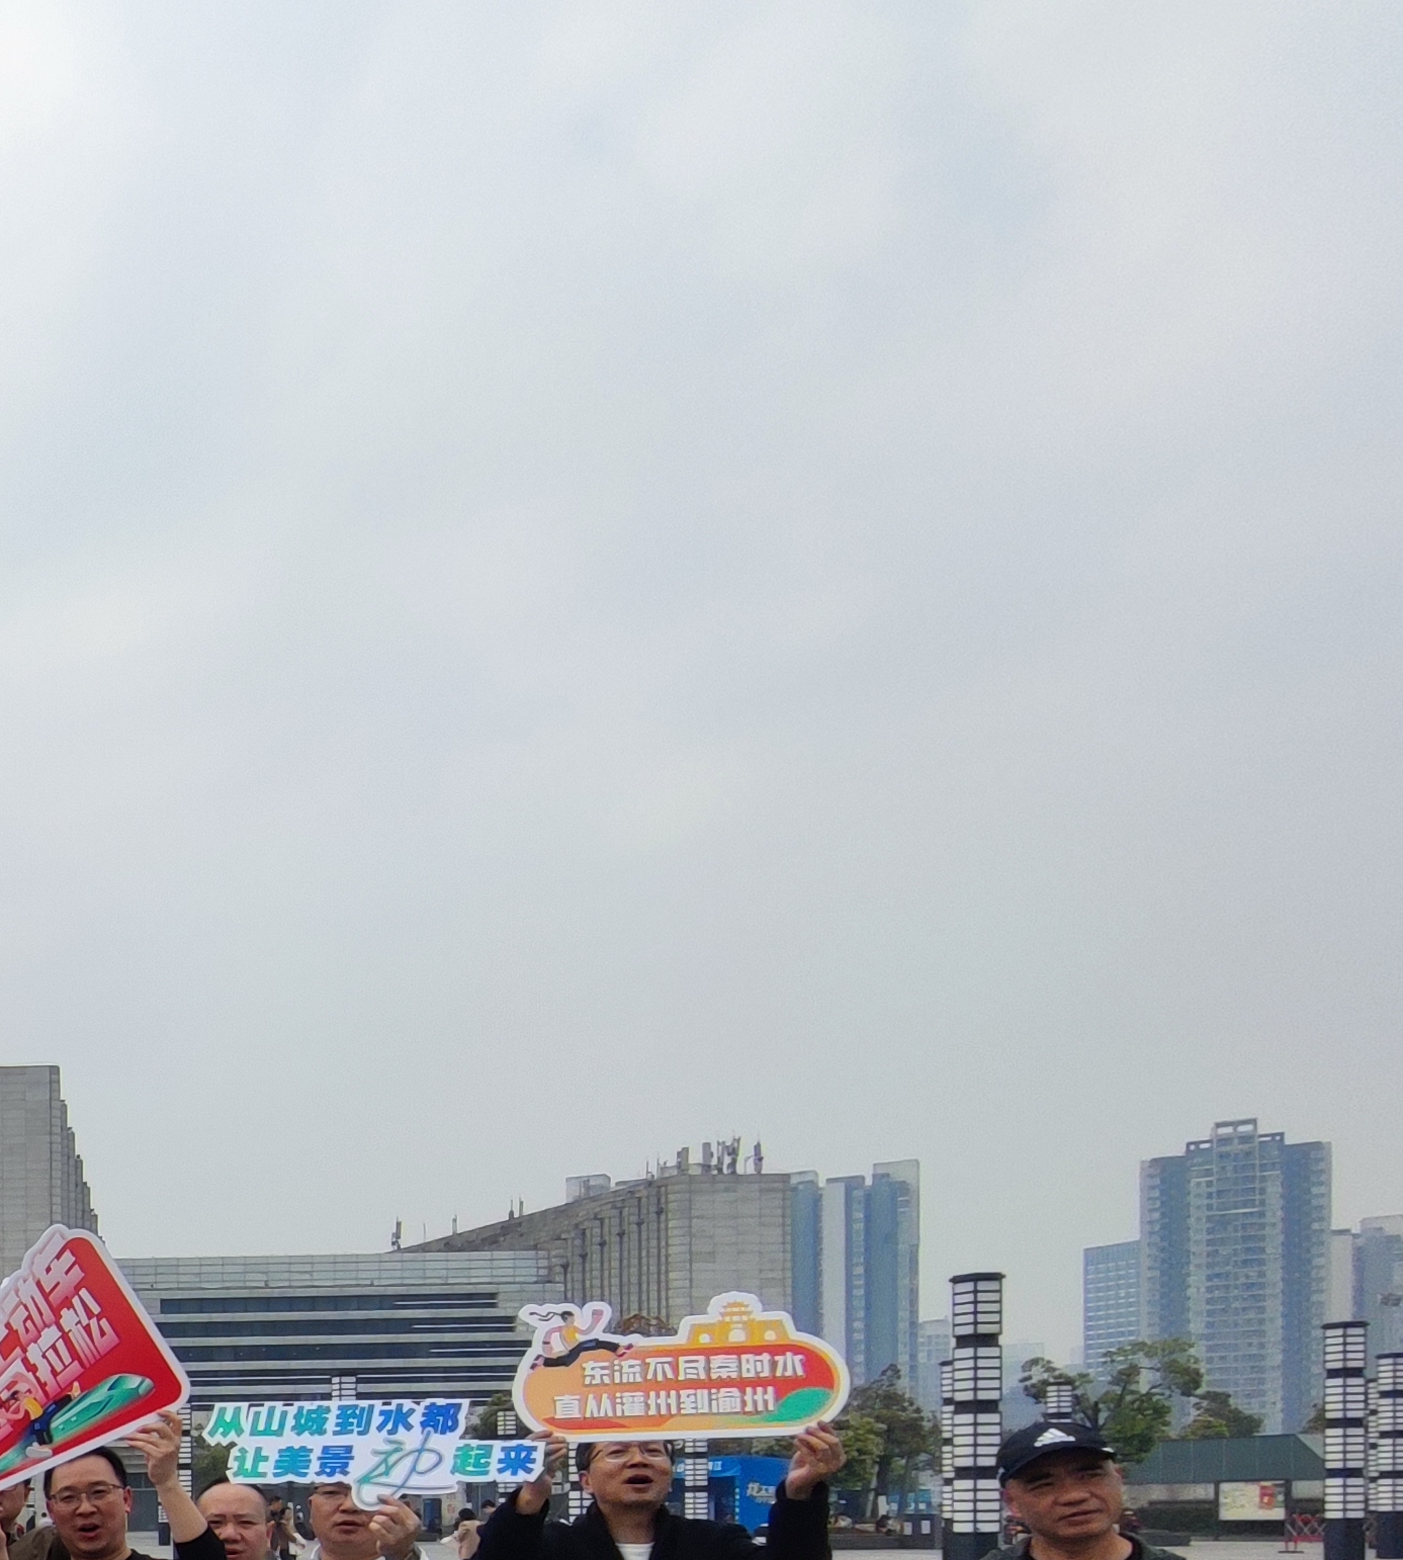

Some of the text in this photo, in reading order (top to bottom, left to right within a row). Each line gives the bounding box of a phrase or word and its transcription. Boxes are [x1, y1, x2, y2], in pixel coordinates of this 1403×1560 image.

[581, 1354, 805, 1386] 东流不尽秦时水
[553, 1386, 777, 1419] 直从灌州到渝州
[210, 1402, 459, 1439] 从山城到水都
